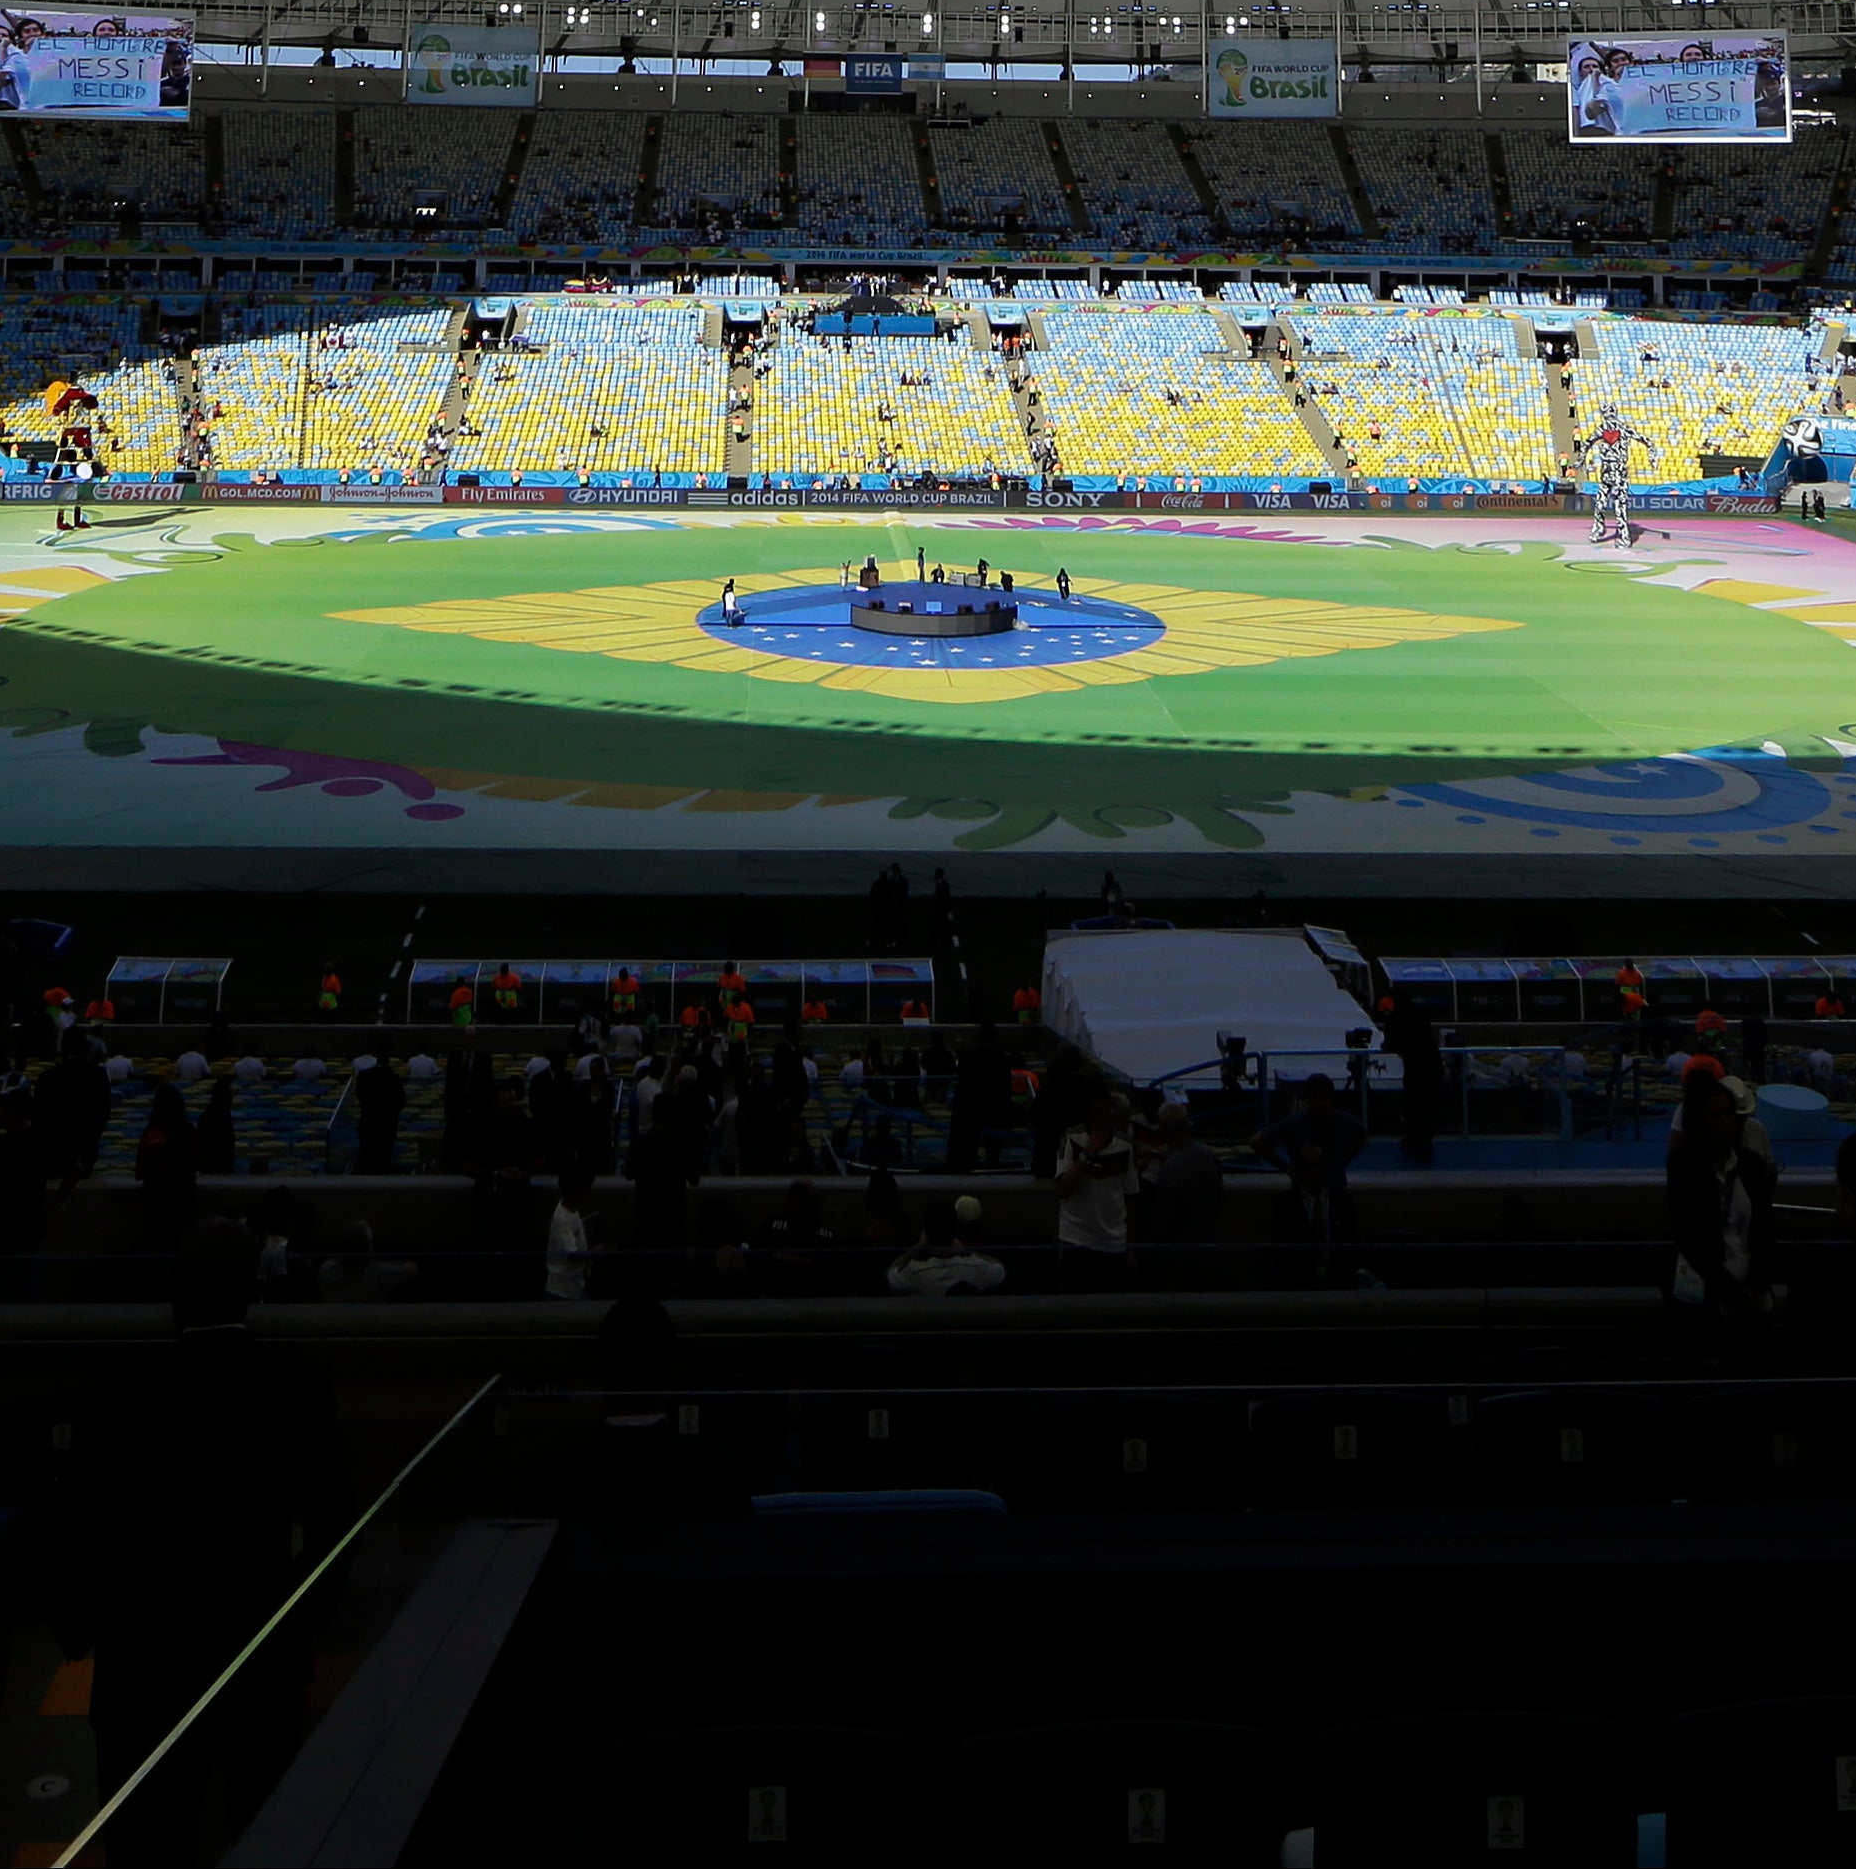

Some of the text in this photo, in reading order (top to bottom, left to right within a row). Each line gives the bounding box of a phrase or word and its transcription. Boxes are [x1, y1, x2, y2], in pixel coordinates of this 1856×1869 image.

[38, 37, 166, 54] EL HOMBRE
[454, 52, 530, 61] FIFA WORLD CUP
[451, 62, 529, 87] Brasil
[854, 62, 894, 77] FIFA
[1251, 64, 1329, 73] FIFA WORLD CUP
[1627, 61, 1757, 79] EL HOMBRE
[73, 82, 146, 99] RECORD
[1249, 76, 1328, 99] Brasil
[1665, 106, 1741, 122] RECORD
[828, 249, 846, 259] FIFA
[849, 249, 875, 259] World
[878, 250, 894, 261] Cup
[111, 484, 181, 501] Castrol
[220, 487, 302, 499] GOL.MCD.COM
[329, 485, 379, 502] Johnson
[385, 485, 434, 502] Johnson
[462, 487, 545, 502] Fly Emirates
[599, 489, 678, 503] HYUNDAI
[731, 489, 799, 505] adidas
[811, 492, 995, 504] 2014 FIFA WORLD CUP BRAZIL
[1026, 491, 1106, 508] SONY
[1475, 492, 1550, 508] Continental
[1252, 493, 1293, 509] VISA
[1310, 493, 1351, 509] VISA
[1649, 496, 1705, 510] SOLAR
